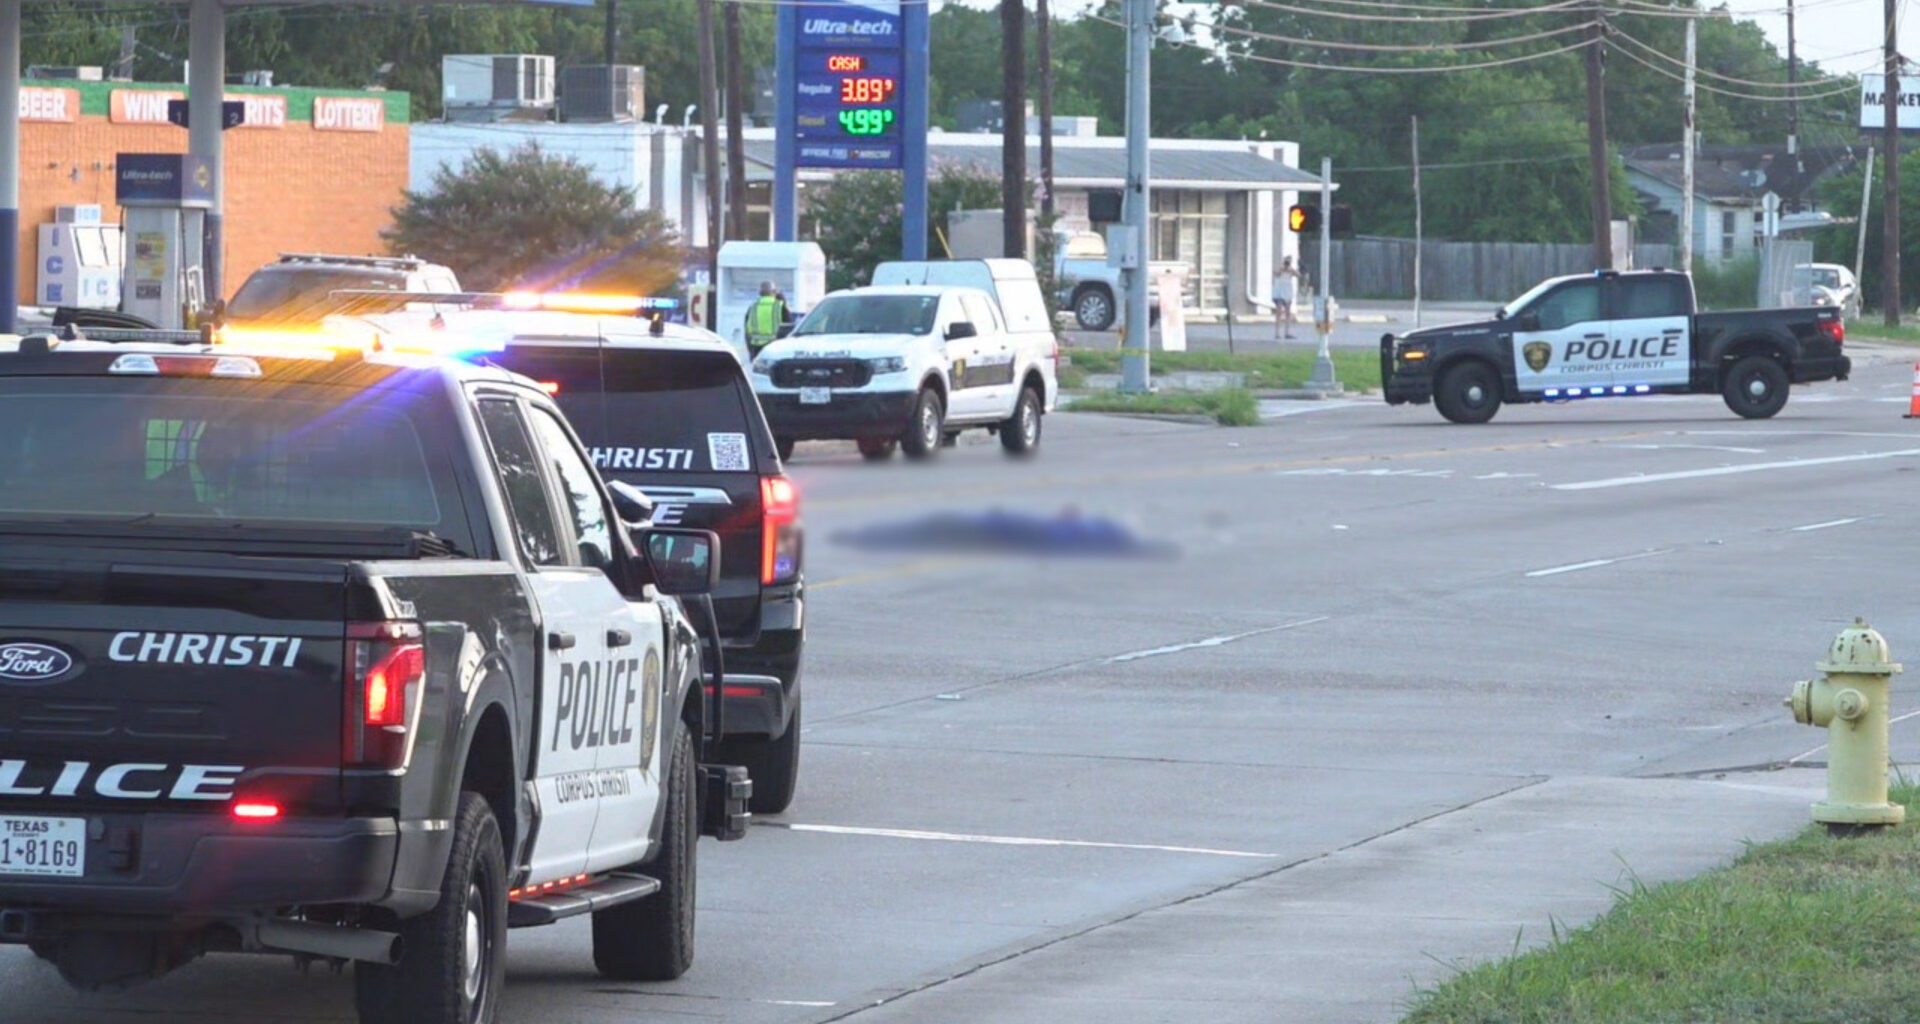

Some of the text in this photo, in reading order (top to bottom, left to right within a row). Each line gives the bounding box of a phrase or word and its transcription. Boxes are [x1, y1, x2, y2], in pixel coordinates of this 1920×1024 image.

[829, 56, 860, 71] CASH
[19, 91, 67, 121] BEER
[1864, 92, 1920, 106] MAKET
[230, 112, 239, 124] 2
[244, 99, 285, 126] RITS
[316, 100, 380, 129] LOTTERY
[1563, 335, 1681, 362] POLICE
[1560, 360, 1665, 374] CORPUS CHRISTI
[585, 447, 694, 469] HRISTI
[0, 647, 55, 673] Ford
[108, 631, 302, 667] CHRISTI
[552, 658, 639, 751] POLICE
[555, 769, 630, 804] CORPUS CHRISTI
[5, 820, 49, 832] TEXAS
